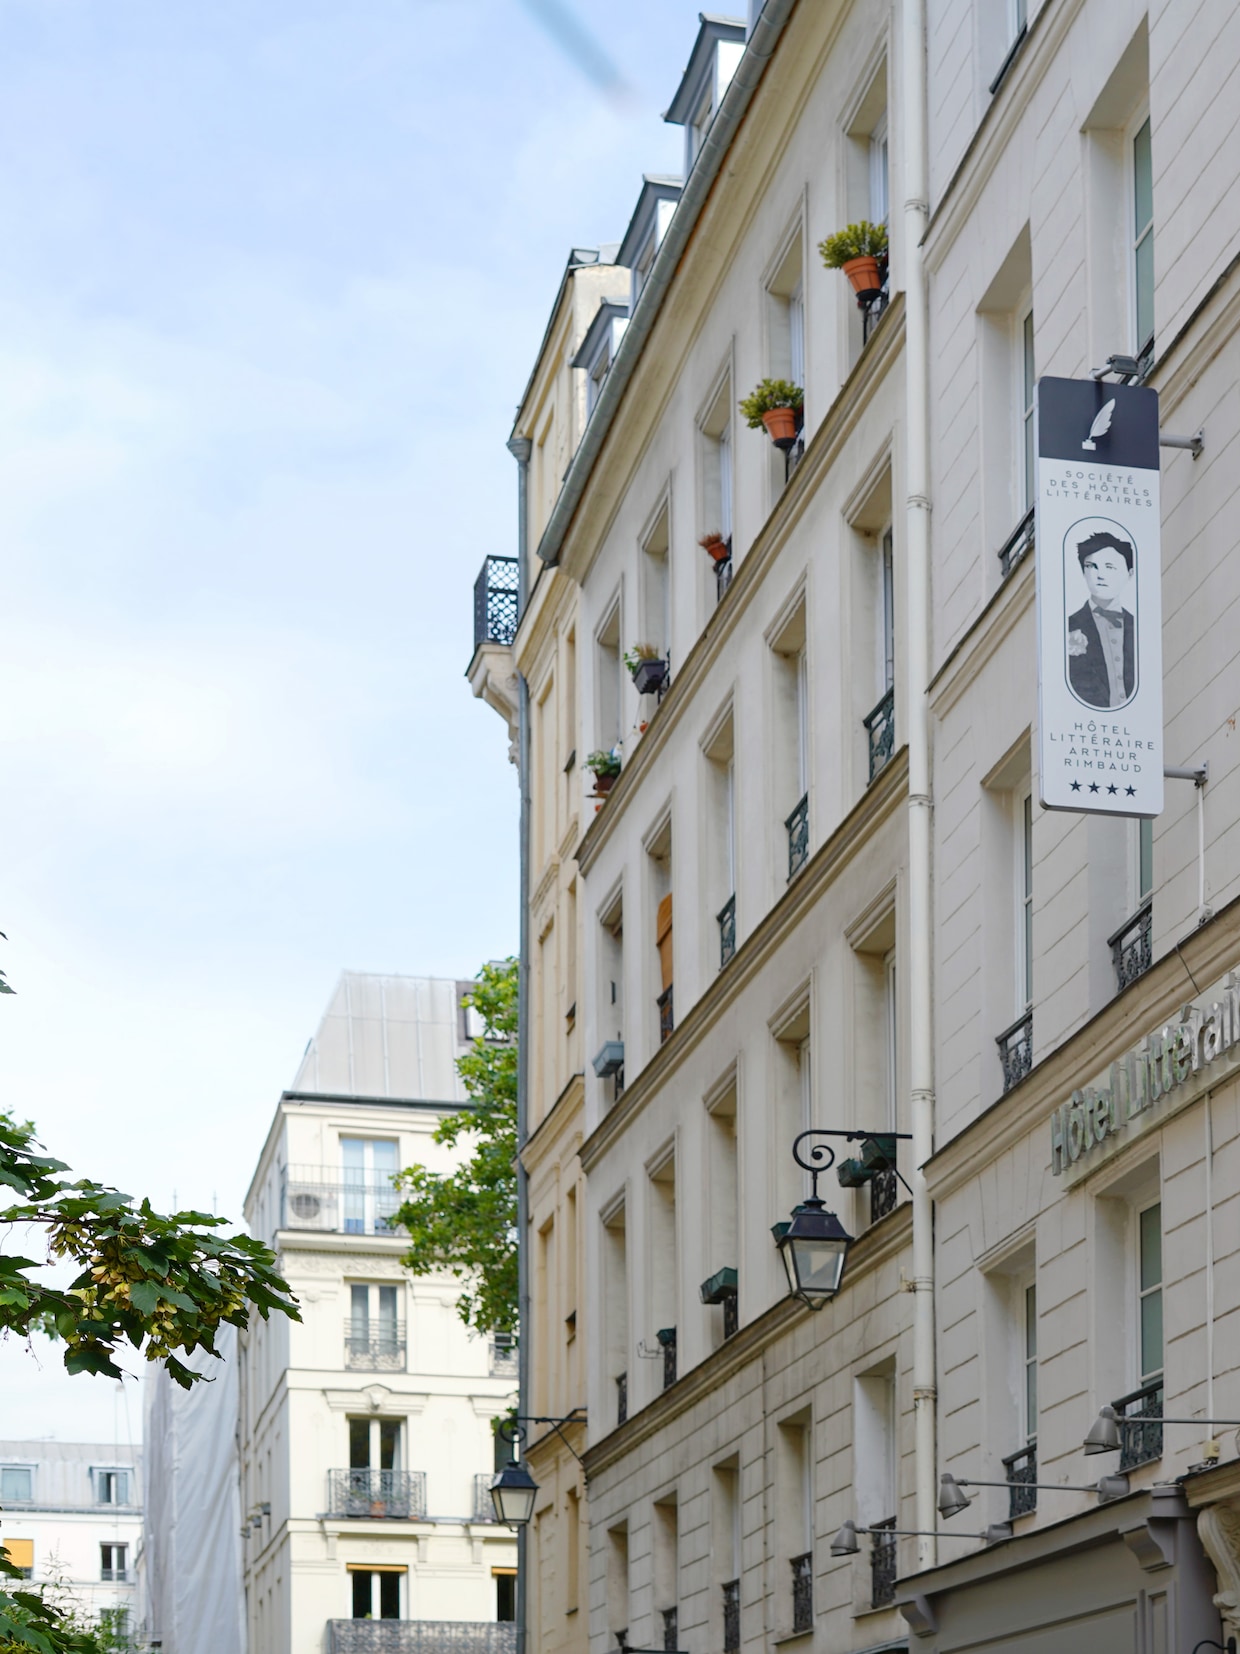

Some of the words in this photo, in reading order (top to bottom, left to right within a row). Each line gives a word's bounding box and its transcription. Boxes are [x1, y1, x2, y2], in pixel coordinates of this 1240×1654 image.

[1065, 470, 1134, 485] SOCIÉTÉ
[1050, 479, 1079, 490] DES
[1089, 481, 1150, 497] HÔTELS
[1046, 489, 1153, 508] LITTÉRAIRES
[1074, 720, 1131, 736] HÔTEL
[1050, 732, 1155, 751] LITTÉRAIRE
[1069, 746, 1137, 761] ARTHUR
[1064, 758, 1142, 773] RIMBAUD
[1050, 1060, 1125, 1177] Hôtel
